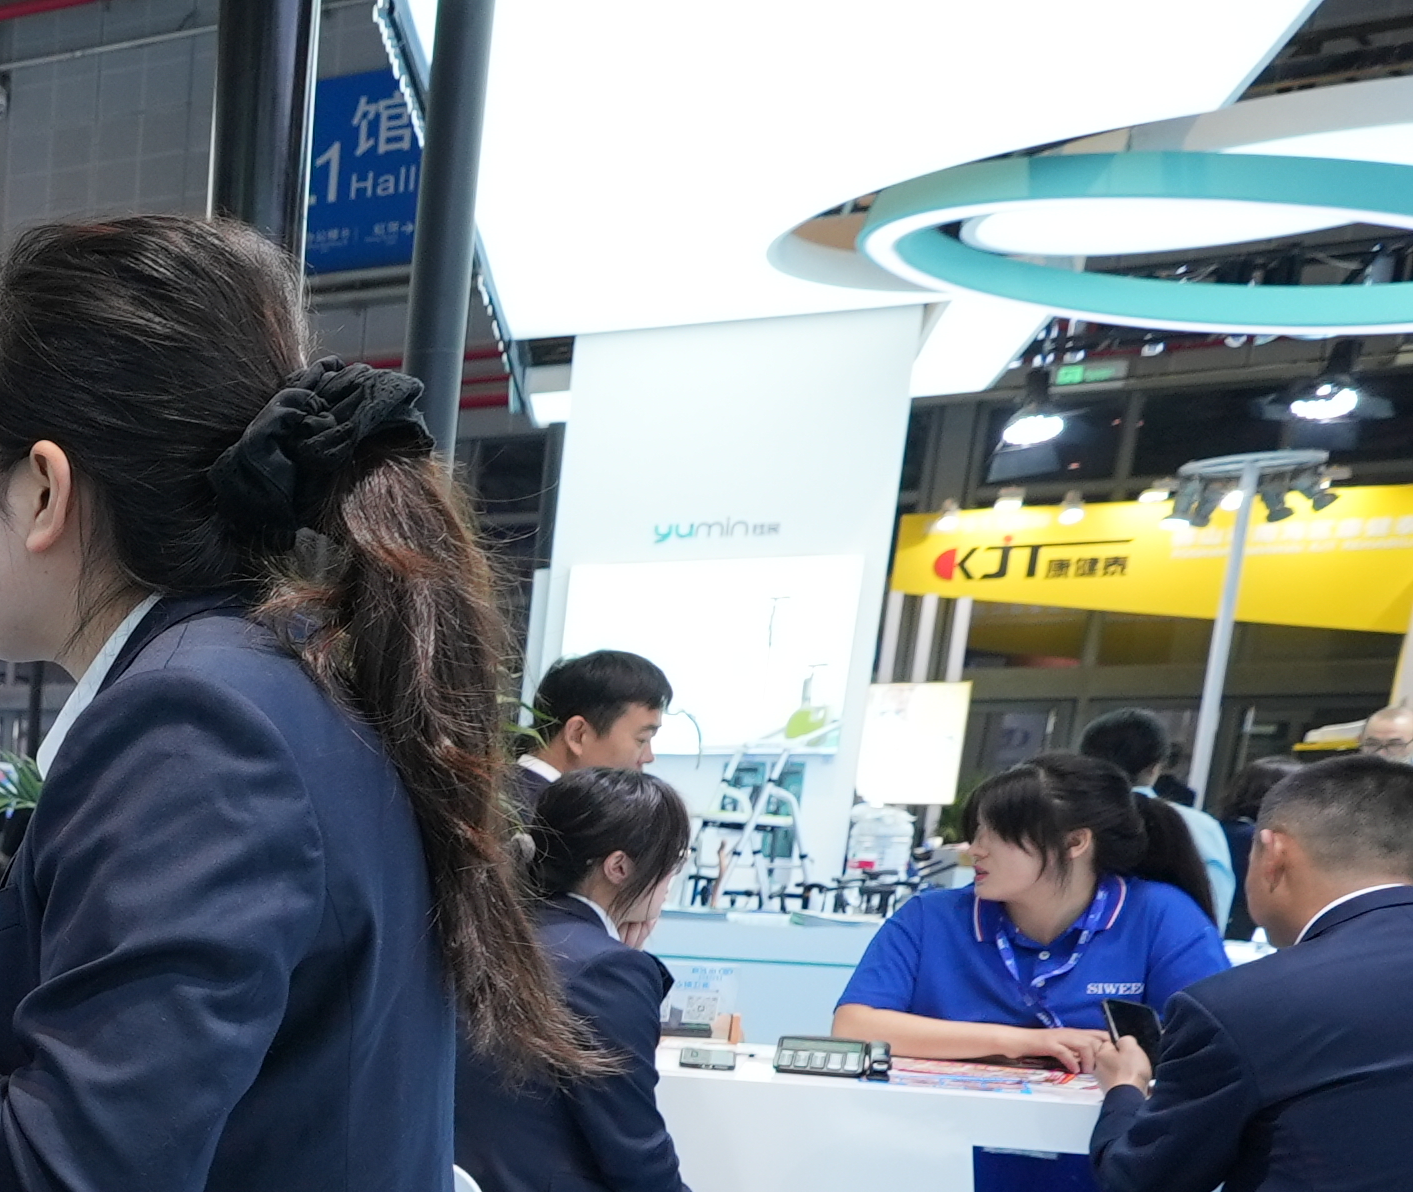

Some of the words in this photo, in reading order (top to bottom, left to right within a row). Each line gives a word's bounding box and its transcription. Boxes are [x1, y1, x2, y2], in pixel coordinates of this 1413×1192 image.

[352, 91, 412, 157] 馆
[349, 164, 417, 200] Hall
[654, 516, 749, 543] yumin
[1045, 556, 1129, 579] 康健泰
